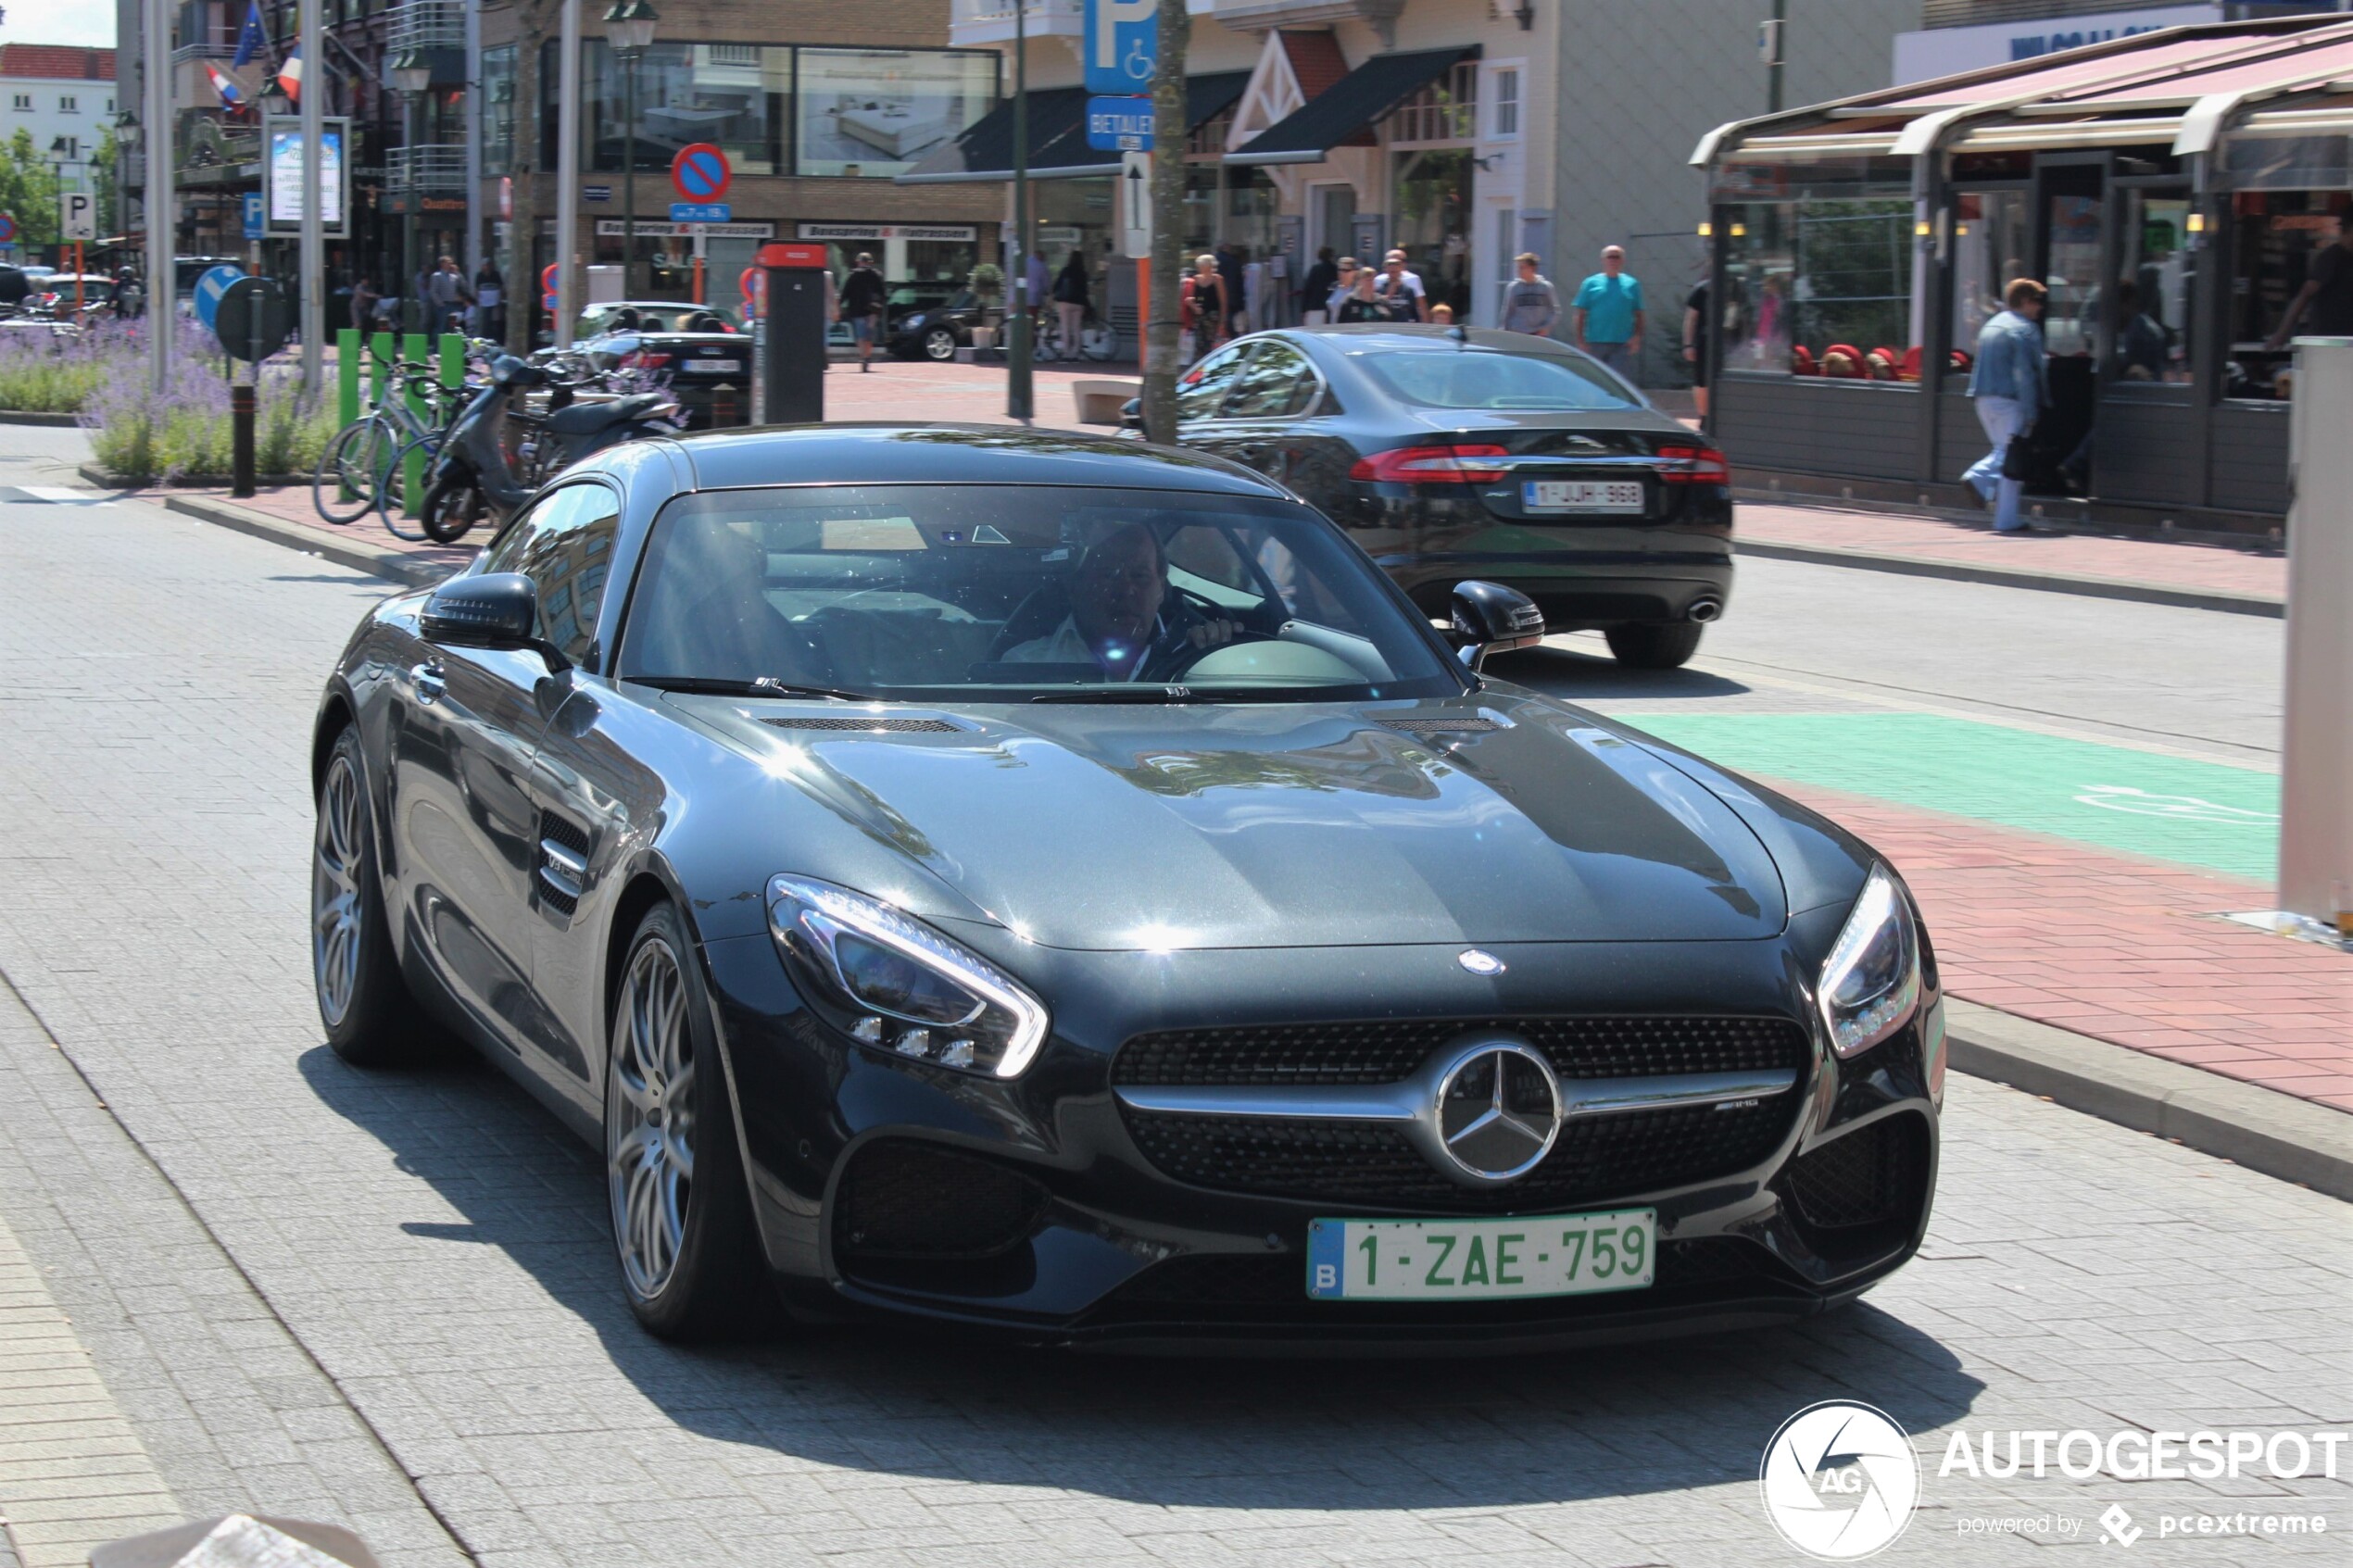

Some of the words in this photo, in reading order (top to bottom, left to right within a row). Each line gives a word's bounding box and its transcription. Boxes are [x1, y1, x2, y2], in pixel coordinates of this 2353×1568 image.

[70, 196, 87, 220] P
[1730, 1098, 1758, 1109] AMG
[1316, 1264, 1337, 1288] B
[1359, 1224, 1645, 1286] 1-ZAE-759
